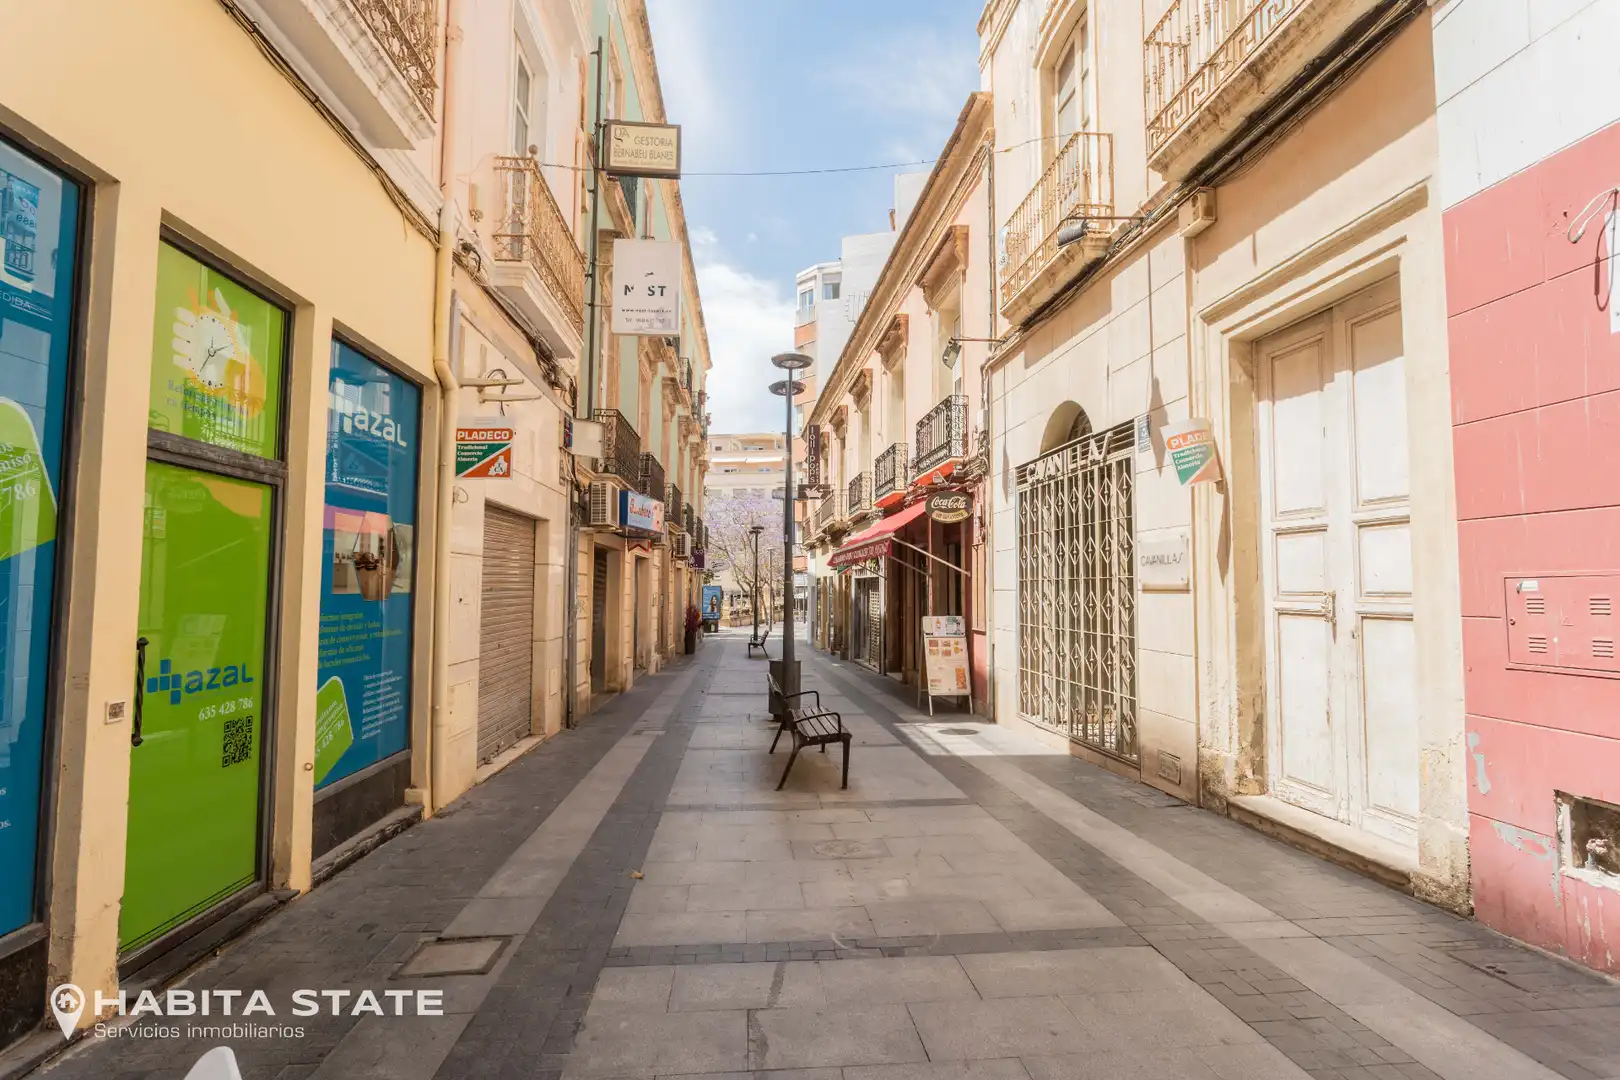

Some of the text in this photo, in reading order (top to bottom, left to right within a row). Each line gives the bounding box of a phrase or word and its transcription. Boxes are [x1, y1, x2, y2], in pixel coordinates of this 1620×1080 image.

[634, 135, 673, 147] GESTORIA
[648, 149, 674, 161] BLANES
[457, 430, 510, 441] PLADECO
[1026, 431, 1113, 484] CAVANILLAS
[1140, 552, 1184, 567] CAVANILLAS
[185, 662, 254, 694] azal
[198, 697, 254, 721] 635 428 786
